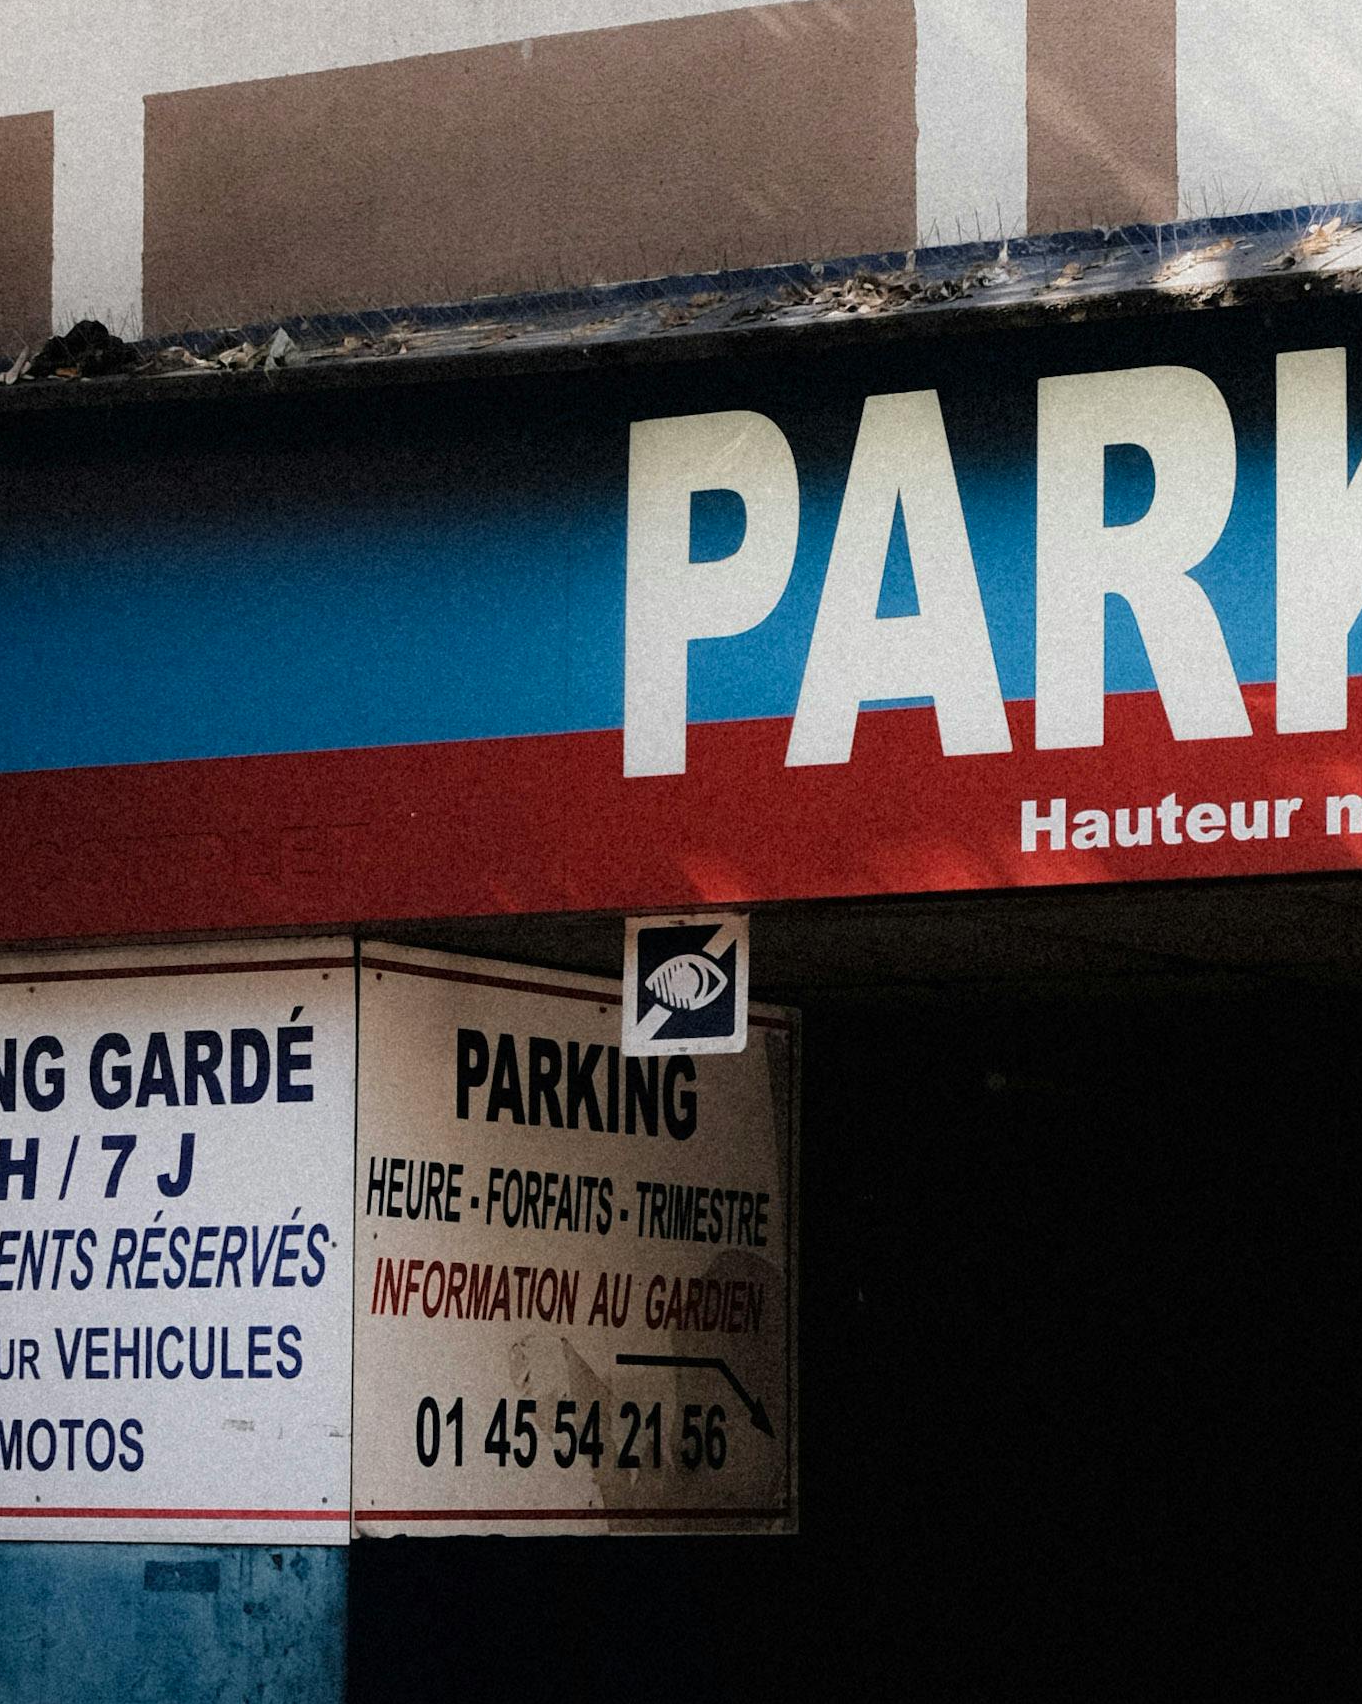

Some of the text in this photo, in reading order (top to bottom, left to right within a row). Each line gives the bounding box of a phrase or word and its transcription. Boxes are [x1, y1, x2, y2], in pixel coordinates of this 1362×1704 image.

[1019, 793, 1303, 854] Hauteur
[88, 1005, 315, 1110] GARDÉ
[455, 1026, 699, 1141] PARKING
[99, 1133, 138, 1199] 7
[155, 1132, 196, 1198] J
[366, 1155, 464, 1223] HEURE
[486, 1166, 614, 1236] FORFAITS
[636, 1180, 770, 1248] TRIMESTRE
[105, 1206, 331, 1291] RÉSERVÉS
[371, 1256, 764, 1334] INFORMATION AU GARDIEN
[53, 1324, 304, 1381] VEHICULES
[416, 1395, 727, 1471] 01 45 54 21 56
